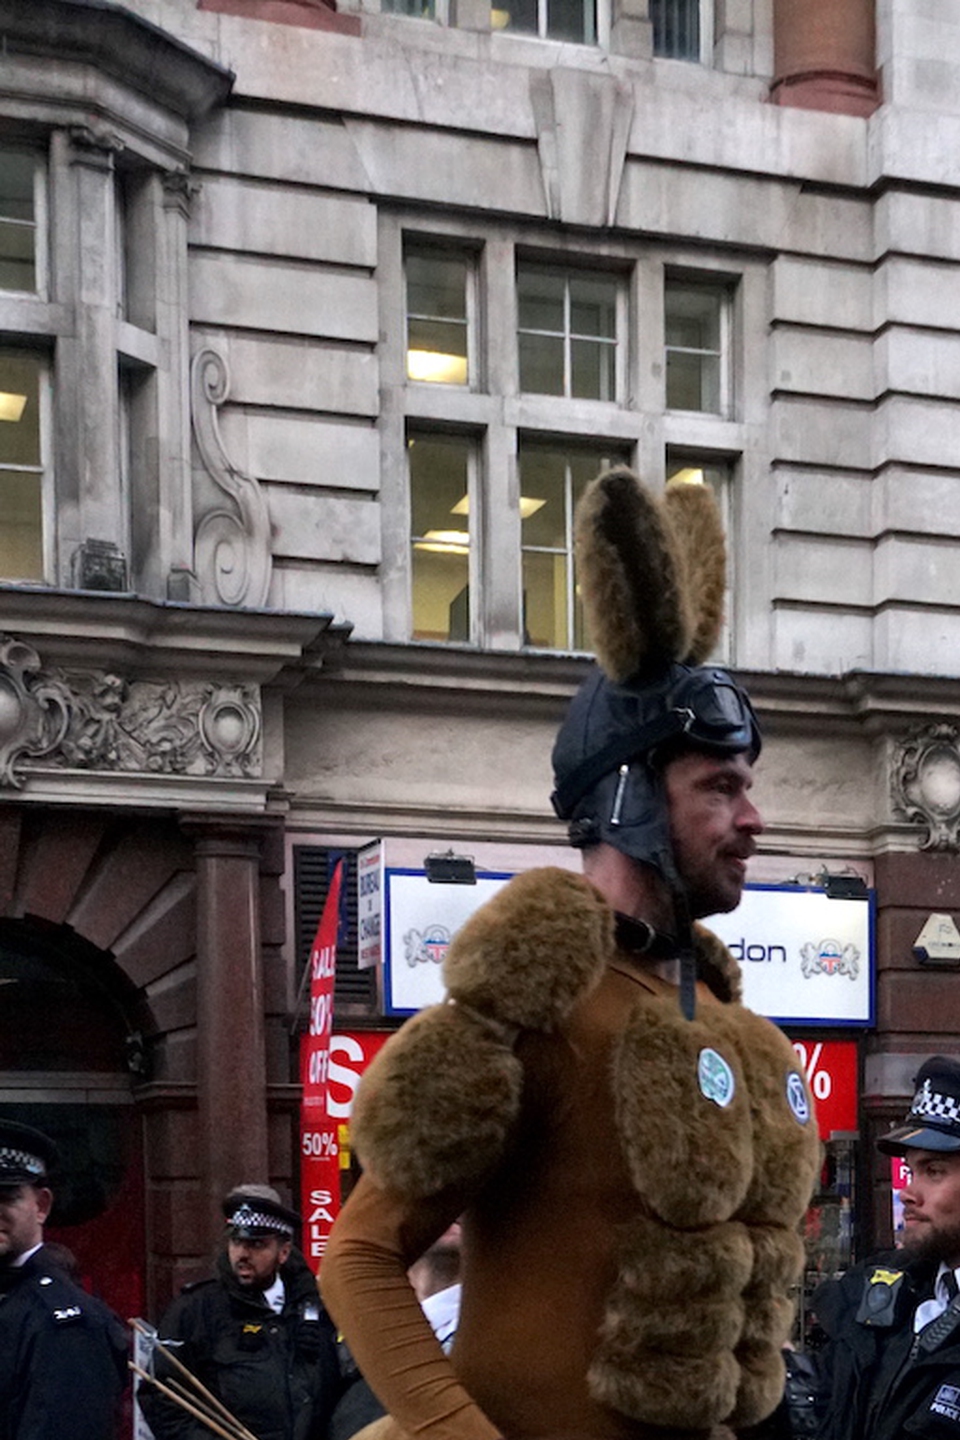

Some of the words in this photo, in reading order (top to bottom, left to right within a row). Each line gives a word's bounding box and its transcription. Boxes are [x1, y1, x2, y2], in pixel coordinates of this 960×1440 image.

[727, 938, 787, 963] don
[302, 1132, 338, 1156] 50%
[308, 1190, 334, 1257] SALE
[930, 1402, 959, 1421] POLICE
